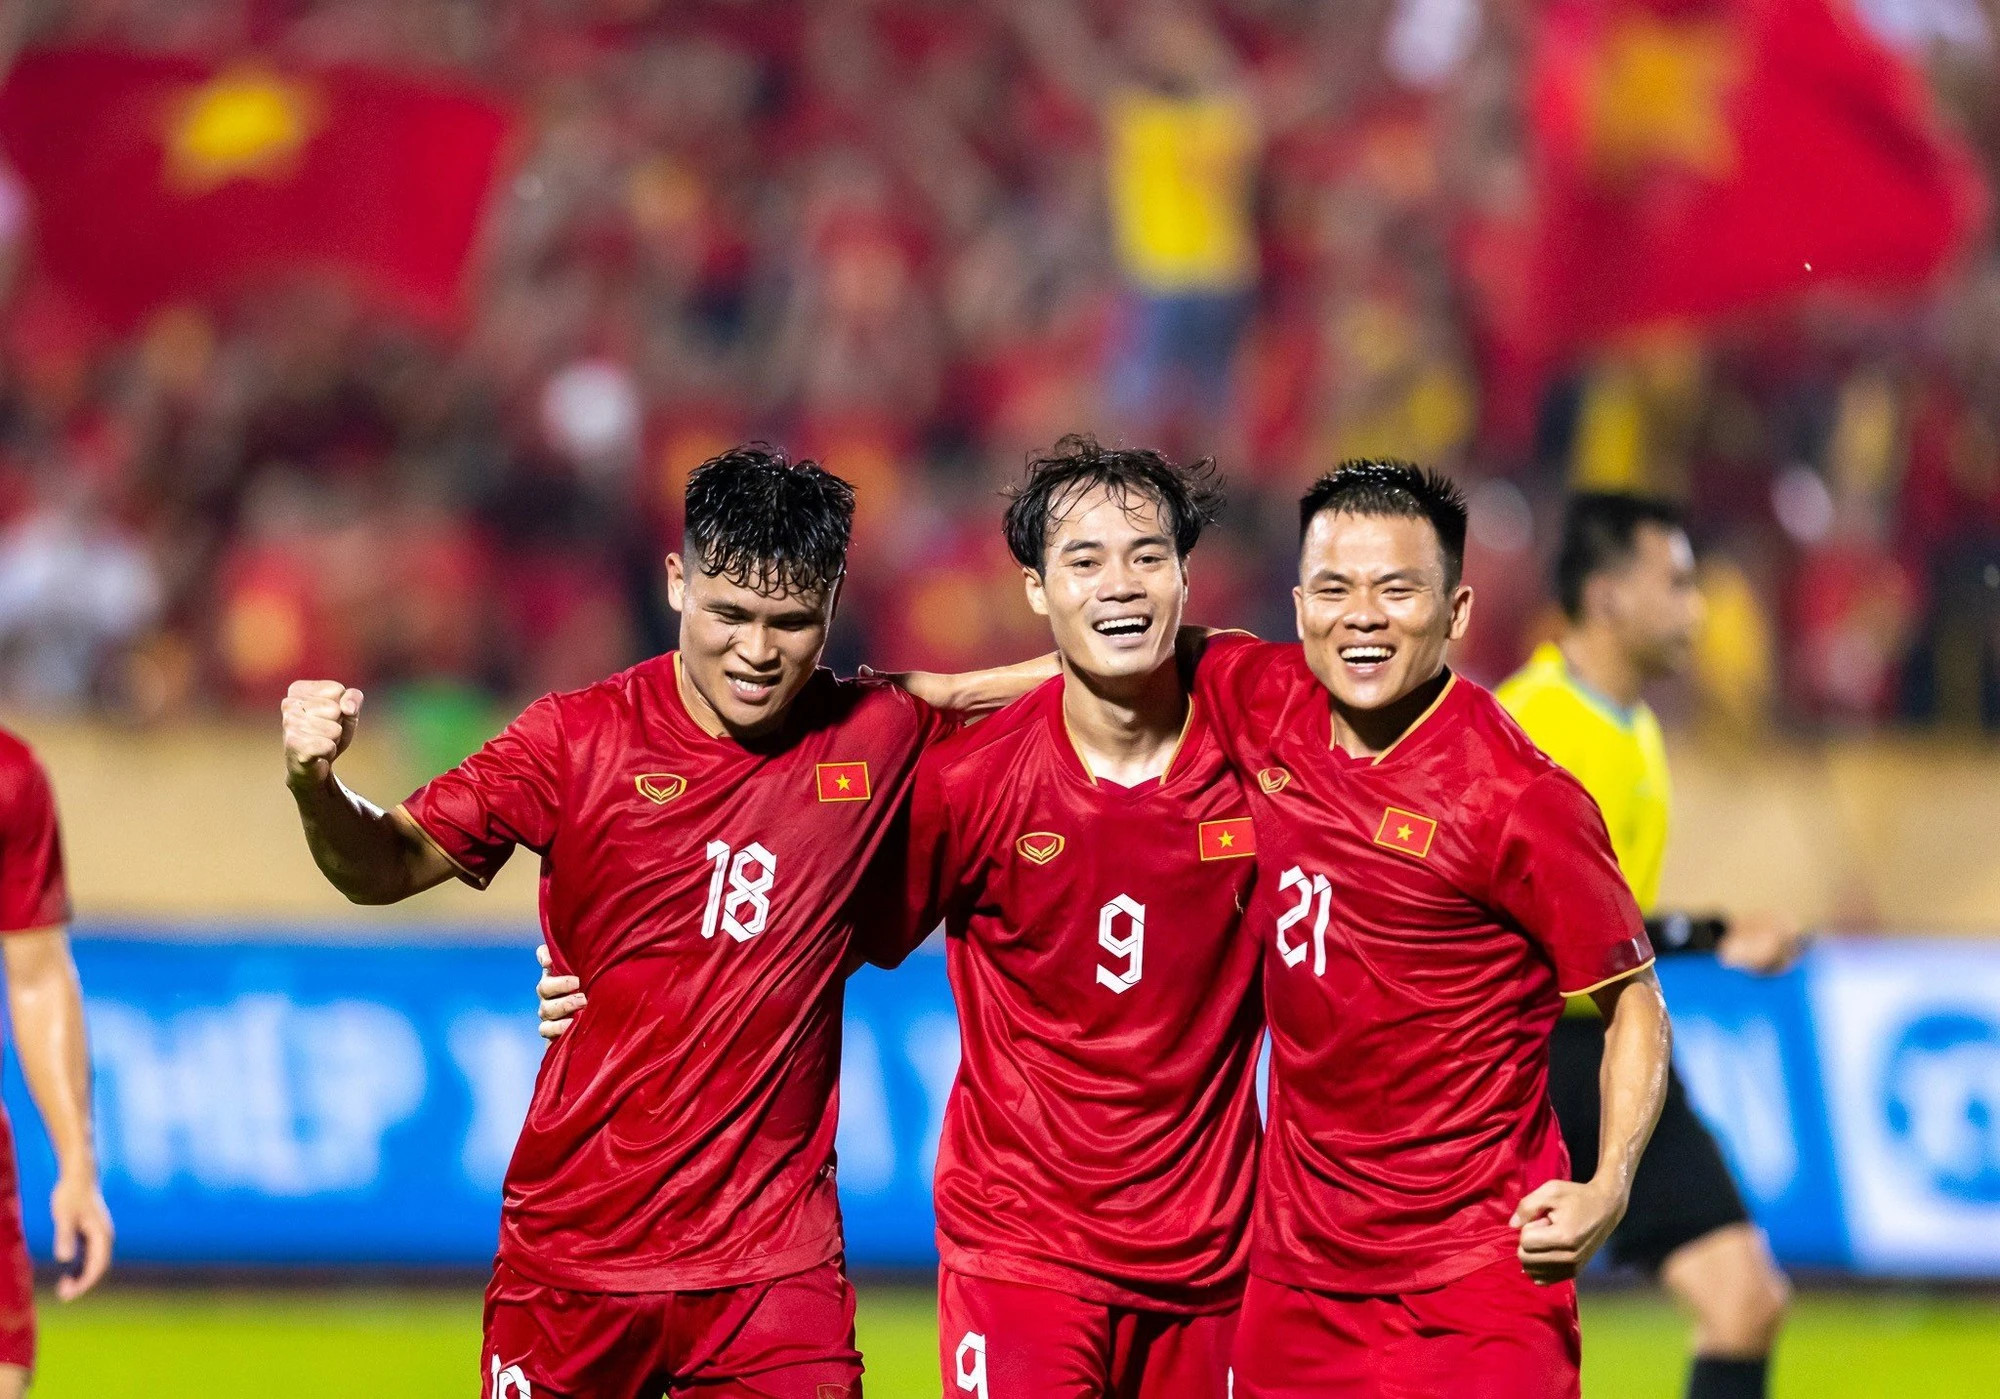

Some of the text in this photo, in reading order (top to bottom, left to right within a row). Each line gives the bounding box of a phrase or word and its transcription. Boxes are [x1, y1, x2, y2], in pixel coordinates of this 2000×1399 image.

[700, 839, 778, 943] 18
[1276, 865, 1333, 977] 21
[1095, 892, 1146, 995] 9
[955, 1330, 989, 1399] 9
